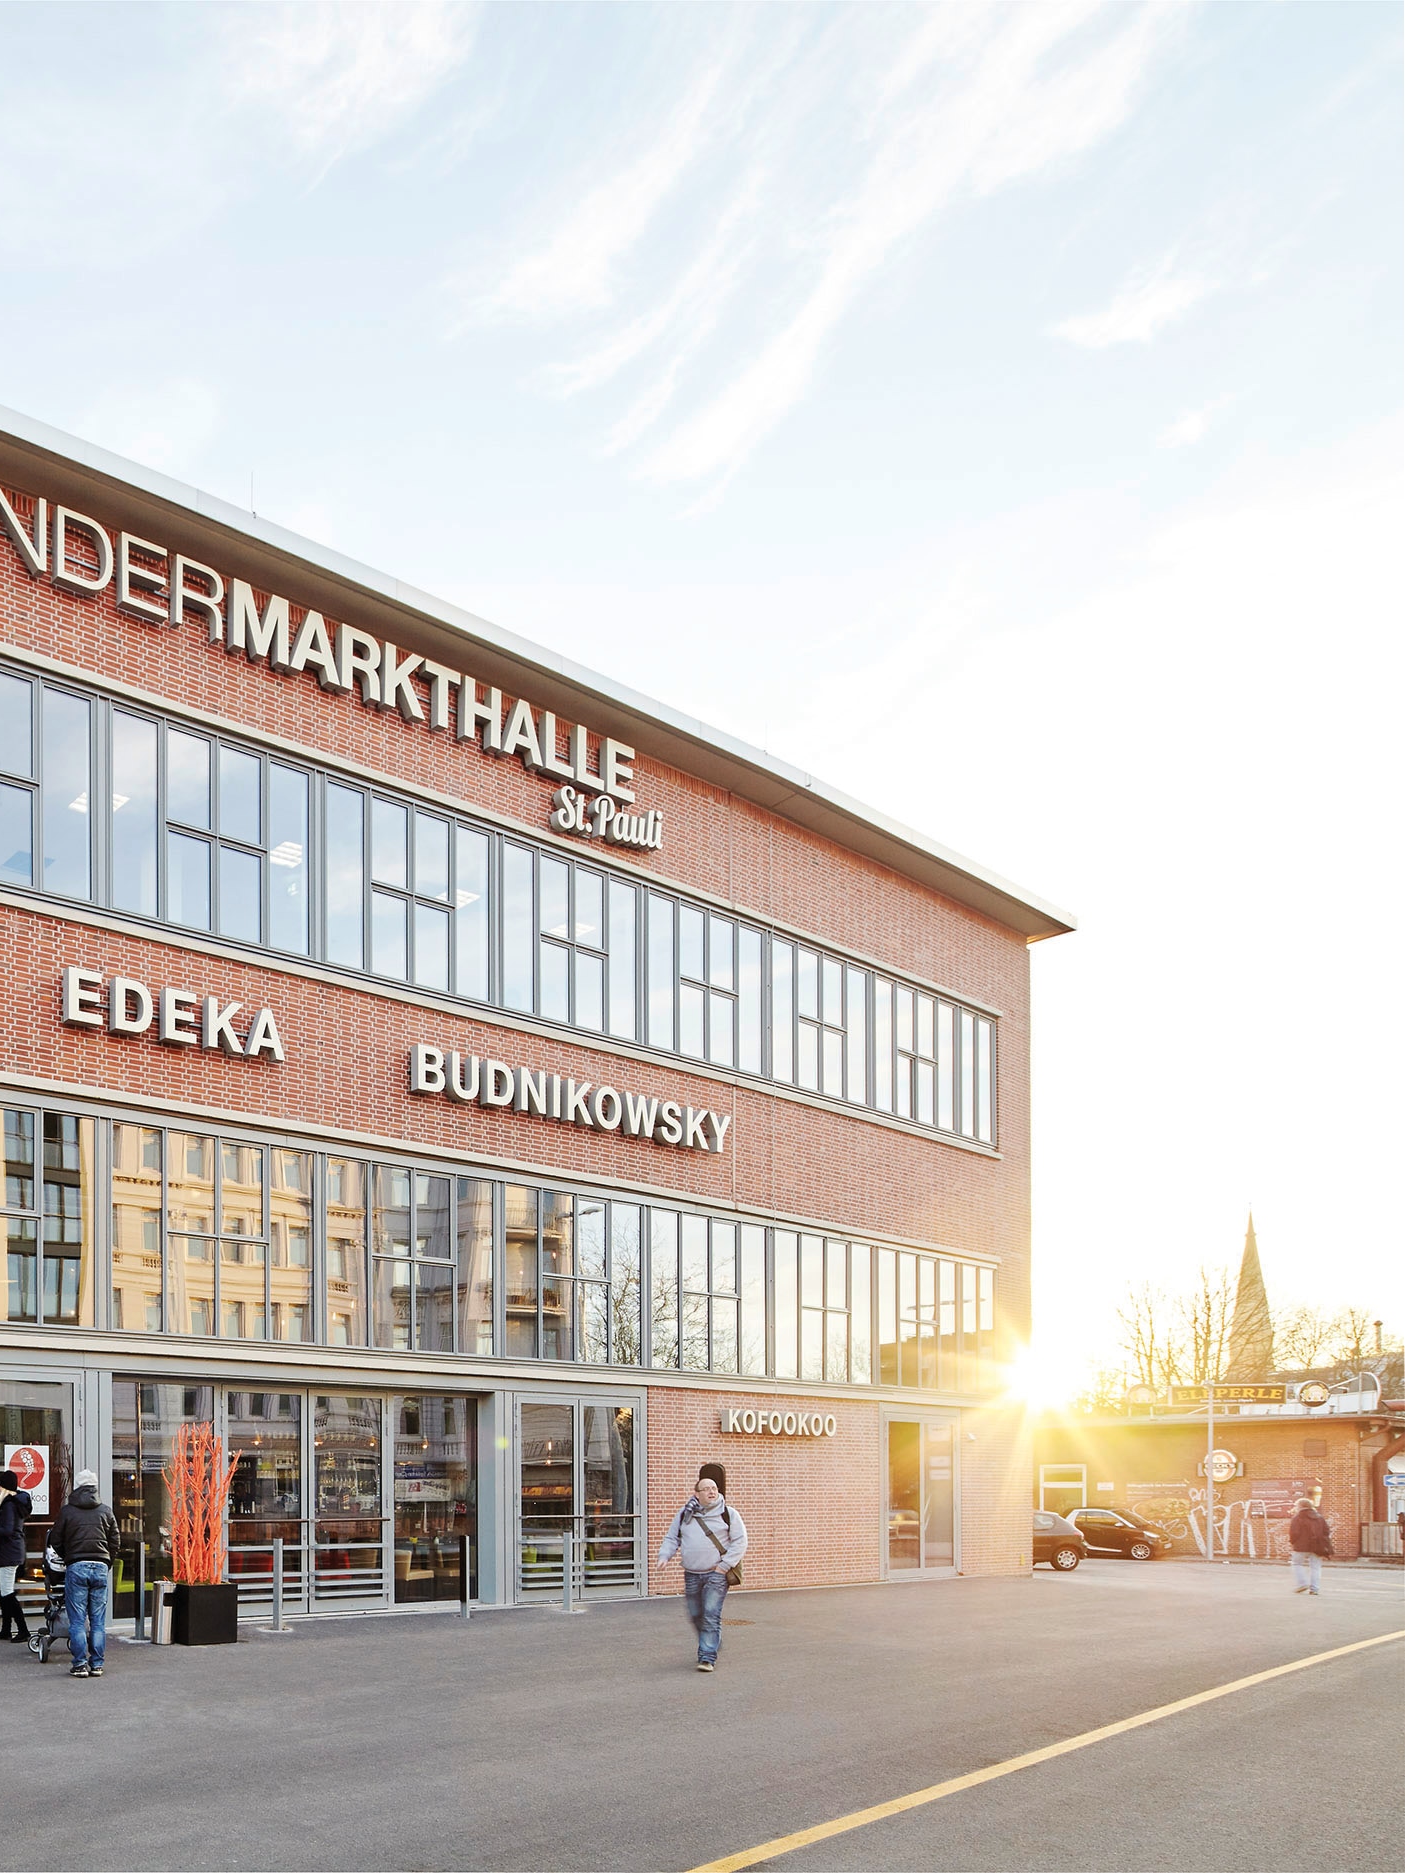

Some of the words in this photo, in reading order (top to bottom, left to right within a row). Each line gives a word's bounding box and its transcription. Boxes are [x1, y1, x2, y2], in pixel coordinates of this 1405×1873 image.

[551, 785, 593, 834] St.
[591, 795, 664, 851] Pauli
[62, 966, 285, 1062] EDEKA
[410, 1043, 731, 1153] BUDNIKOWSKY
[722, 1409, 837, 1437] KOFOOKOO
